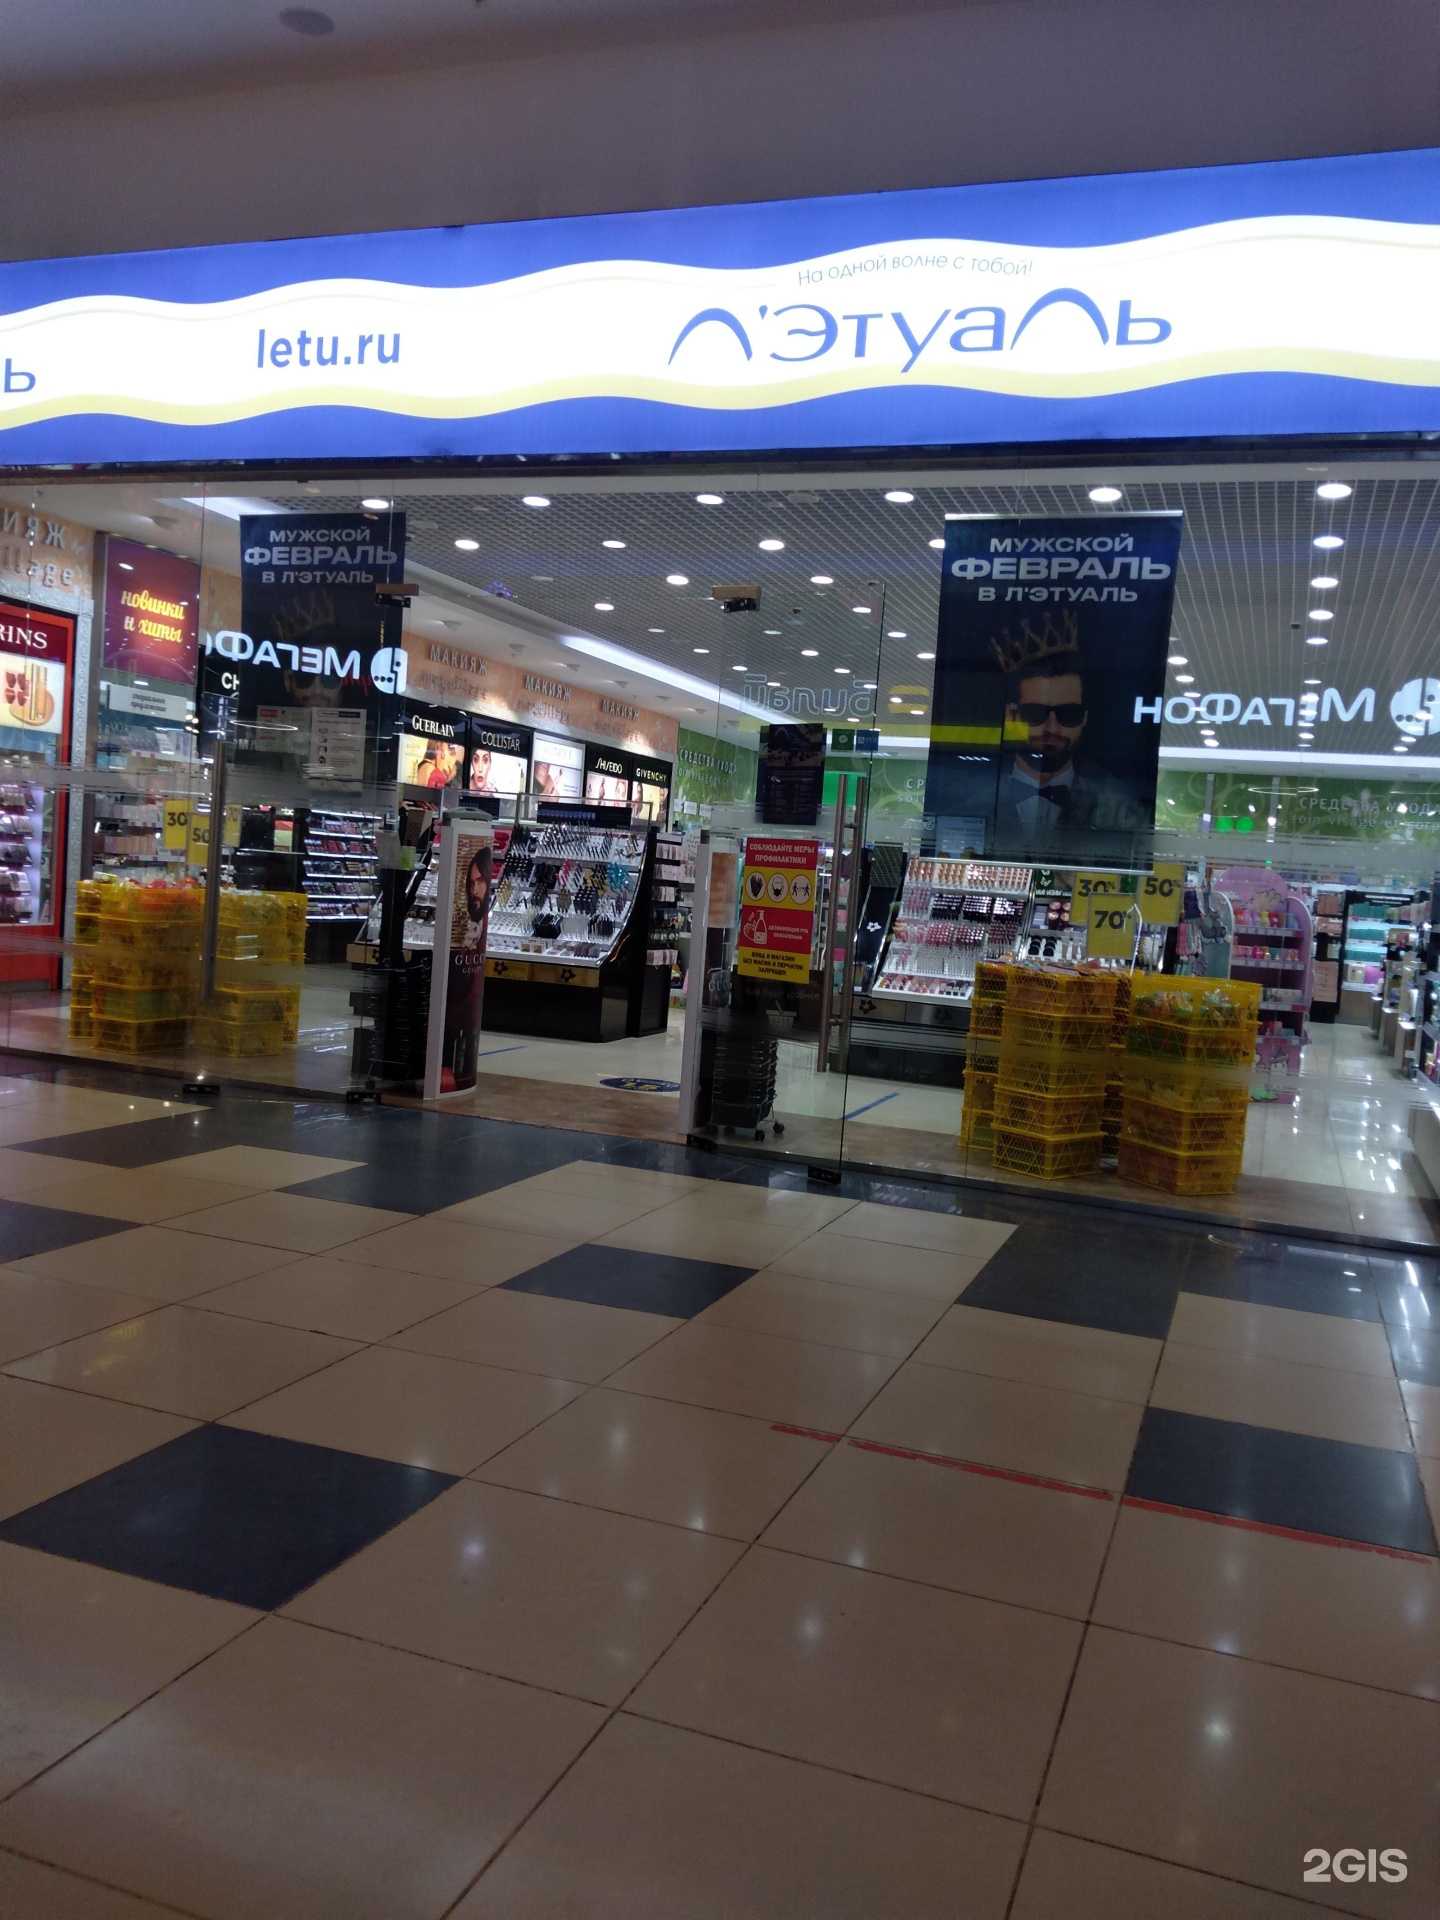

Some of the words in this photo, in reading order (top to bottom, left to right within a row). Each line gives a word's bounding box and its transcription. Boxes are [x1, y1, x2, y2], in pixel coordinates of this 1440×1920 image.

[798, 271, 823, 287] На
[828, 253, 888, 280] одной
[892, 255, 948, 270] волне
[952, 256, 964, 269] с
[970, 257, 1033, 276] тобой!
[257, 328, 401, 369] letu.ru
[270, 526, 371, 543] МУЖСКОЙ
[989, 533, 1134, 553] МУЖСКОЙ
[244, 546, 398, 566] ФЕВРАЛЬ
[261, 571, 275, 584] В
[281, 570, 374, 584] Л'ЭТУАЛЬ
[951, 556, 1171, 580] ФЕВРАЛЬ
[121, 590, 184, 619] новинки
[978, 586, 997, 601] В
[1005, 586, 1138, 602] Л'ЭТУАЛЬ
[412, 714, 455, 738] GUERLAIN
[481, 730, 521, 752] COLLISTAR
[636, 767, 668, 783] GIVENCHY
